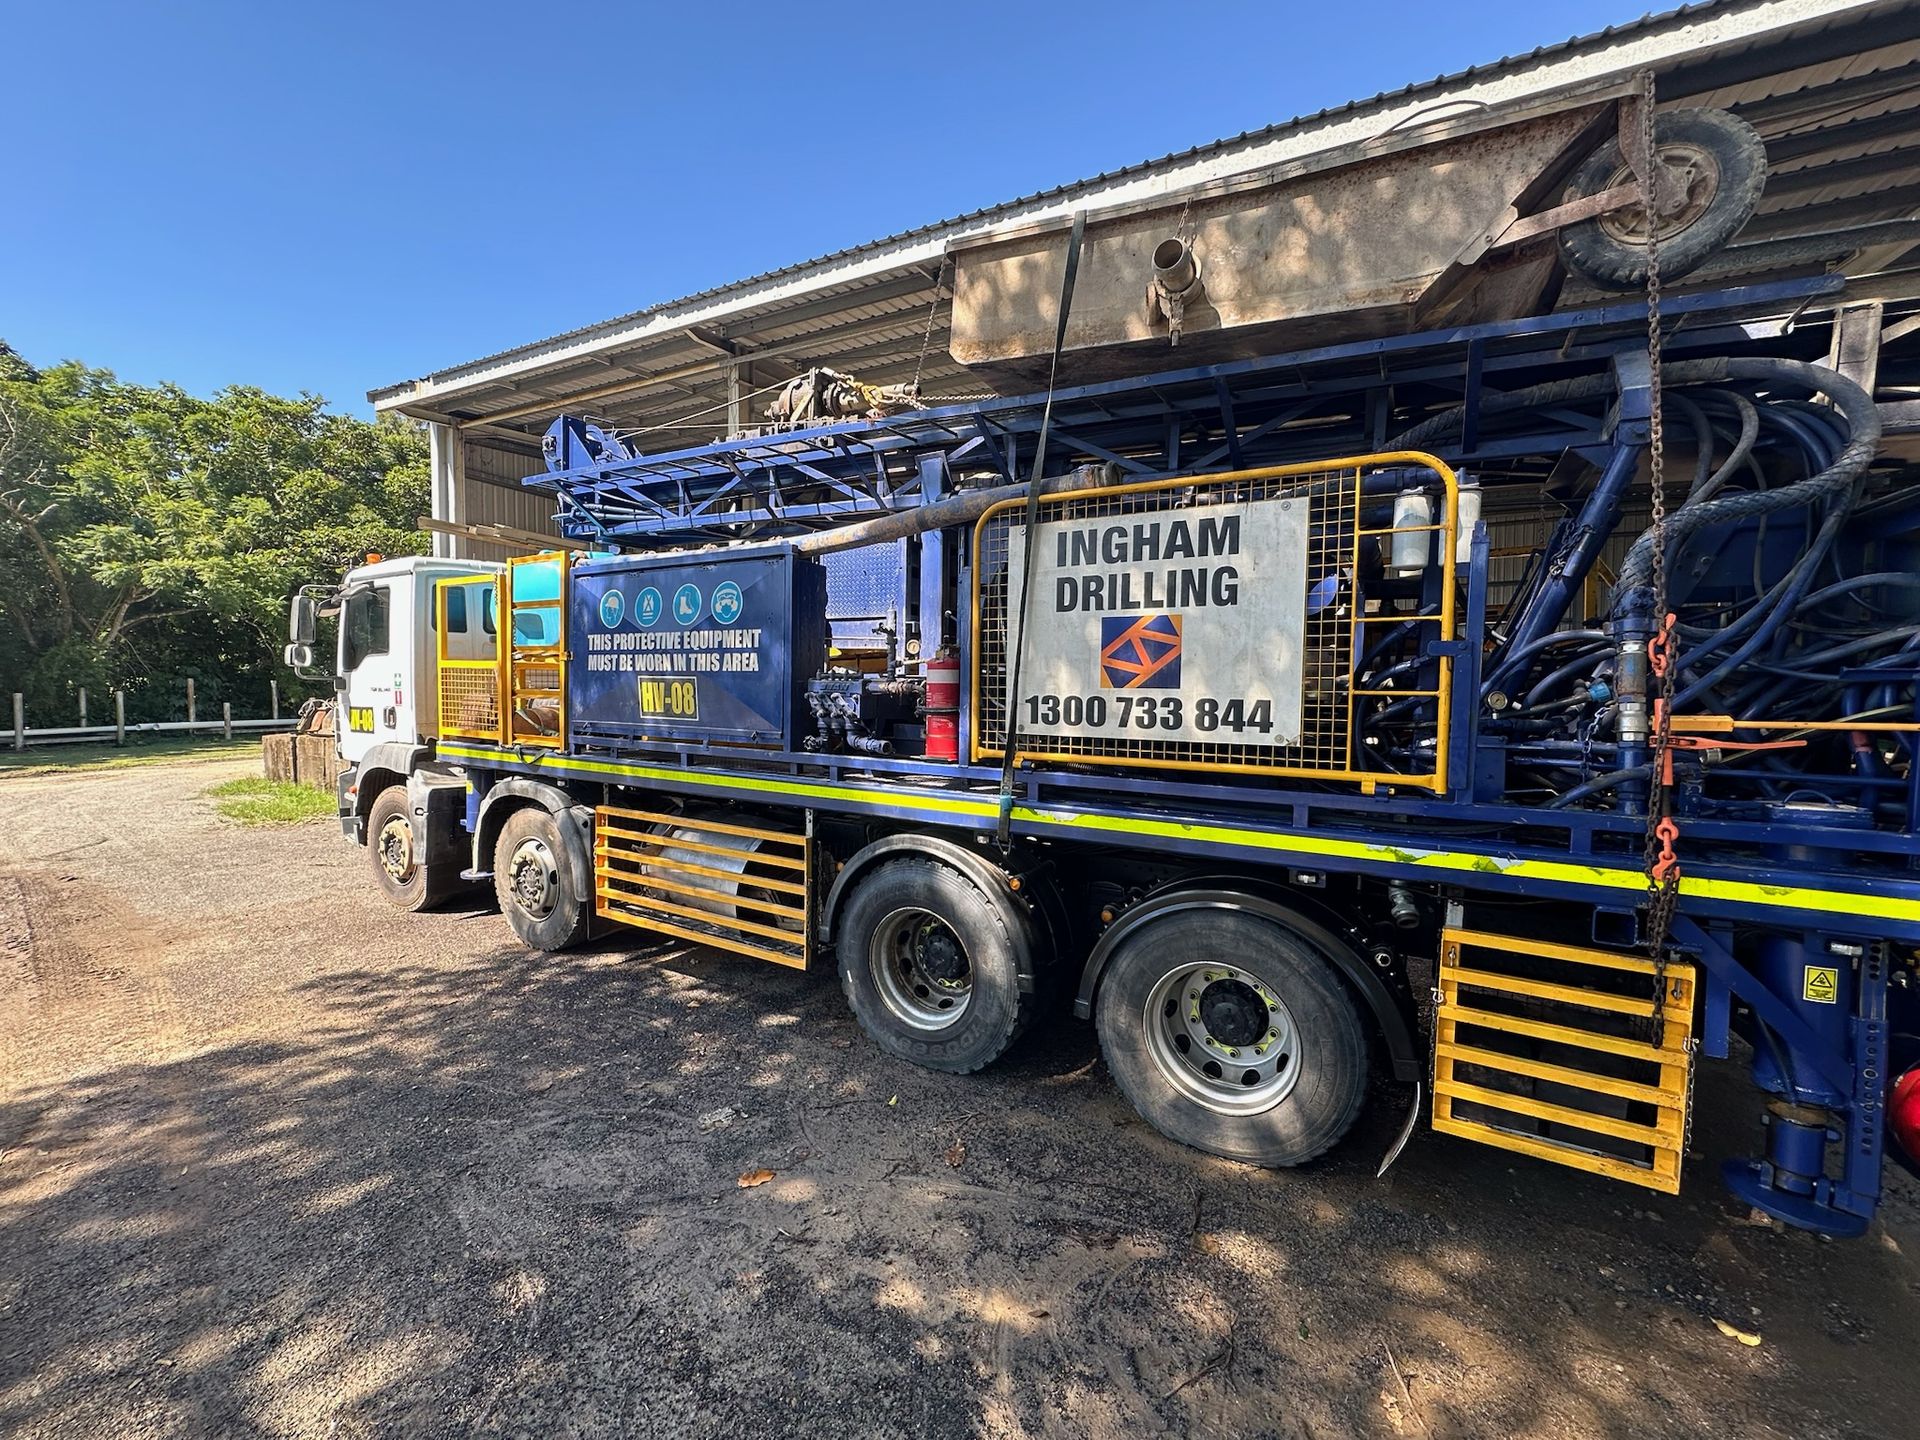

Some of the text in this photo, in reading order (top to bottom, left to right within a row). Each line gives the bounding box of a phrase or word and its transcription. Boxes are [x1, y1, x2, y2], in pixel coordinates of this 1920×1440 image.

[1057, 516, 1240, 566] INGHAM
[1056, 566, 1238, 611] DRILLING
[587, 629, 761, 651] THIS PROTECTIVE EQUIPMENT
[587, 652, 759, 672] MUST BE WORN IN THIS AREA
[641, 681, 696, 715] HV-08
[1025, 695, 1274, 734] 1300 733 844
